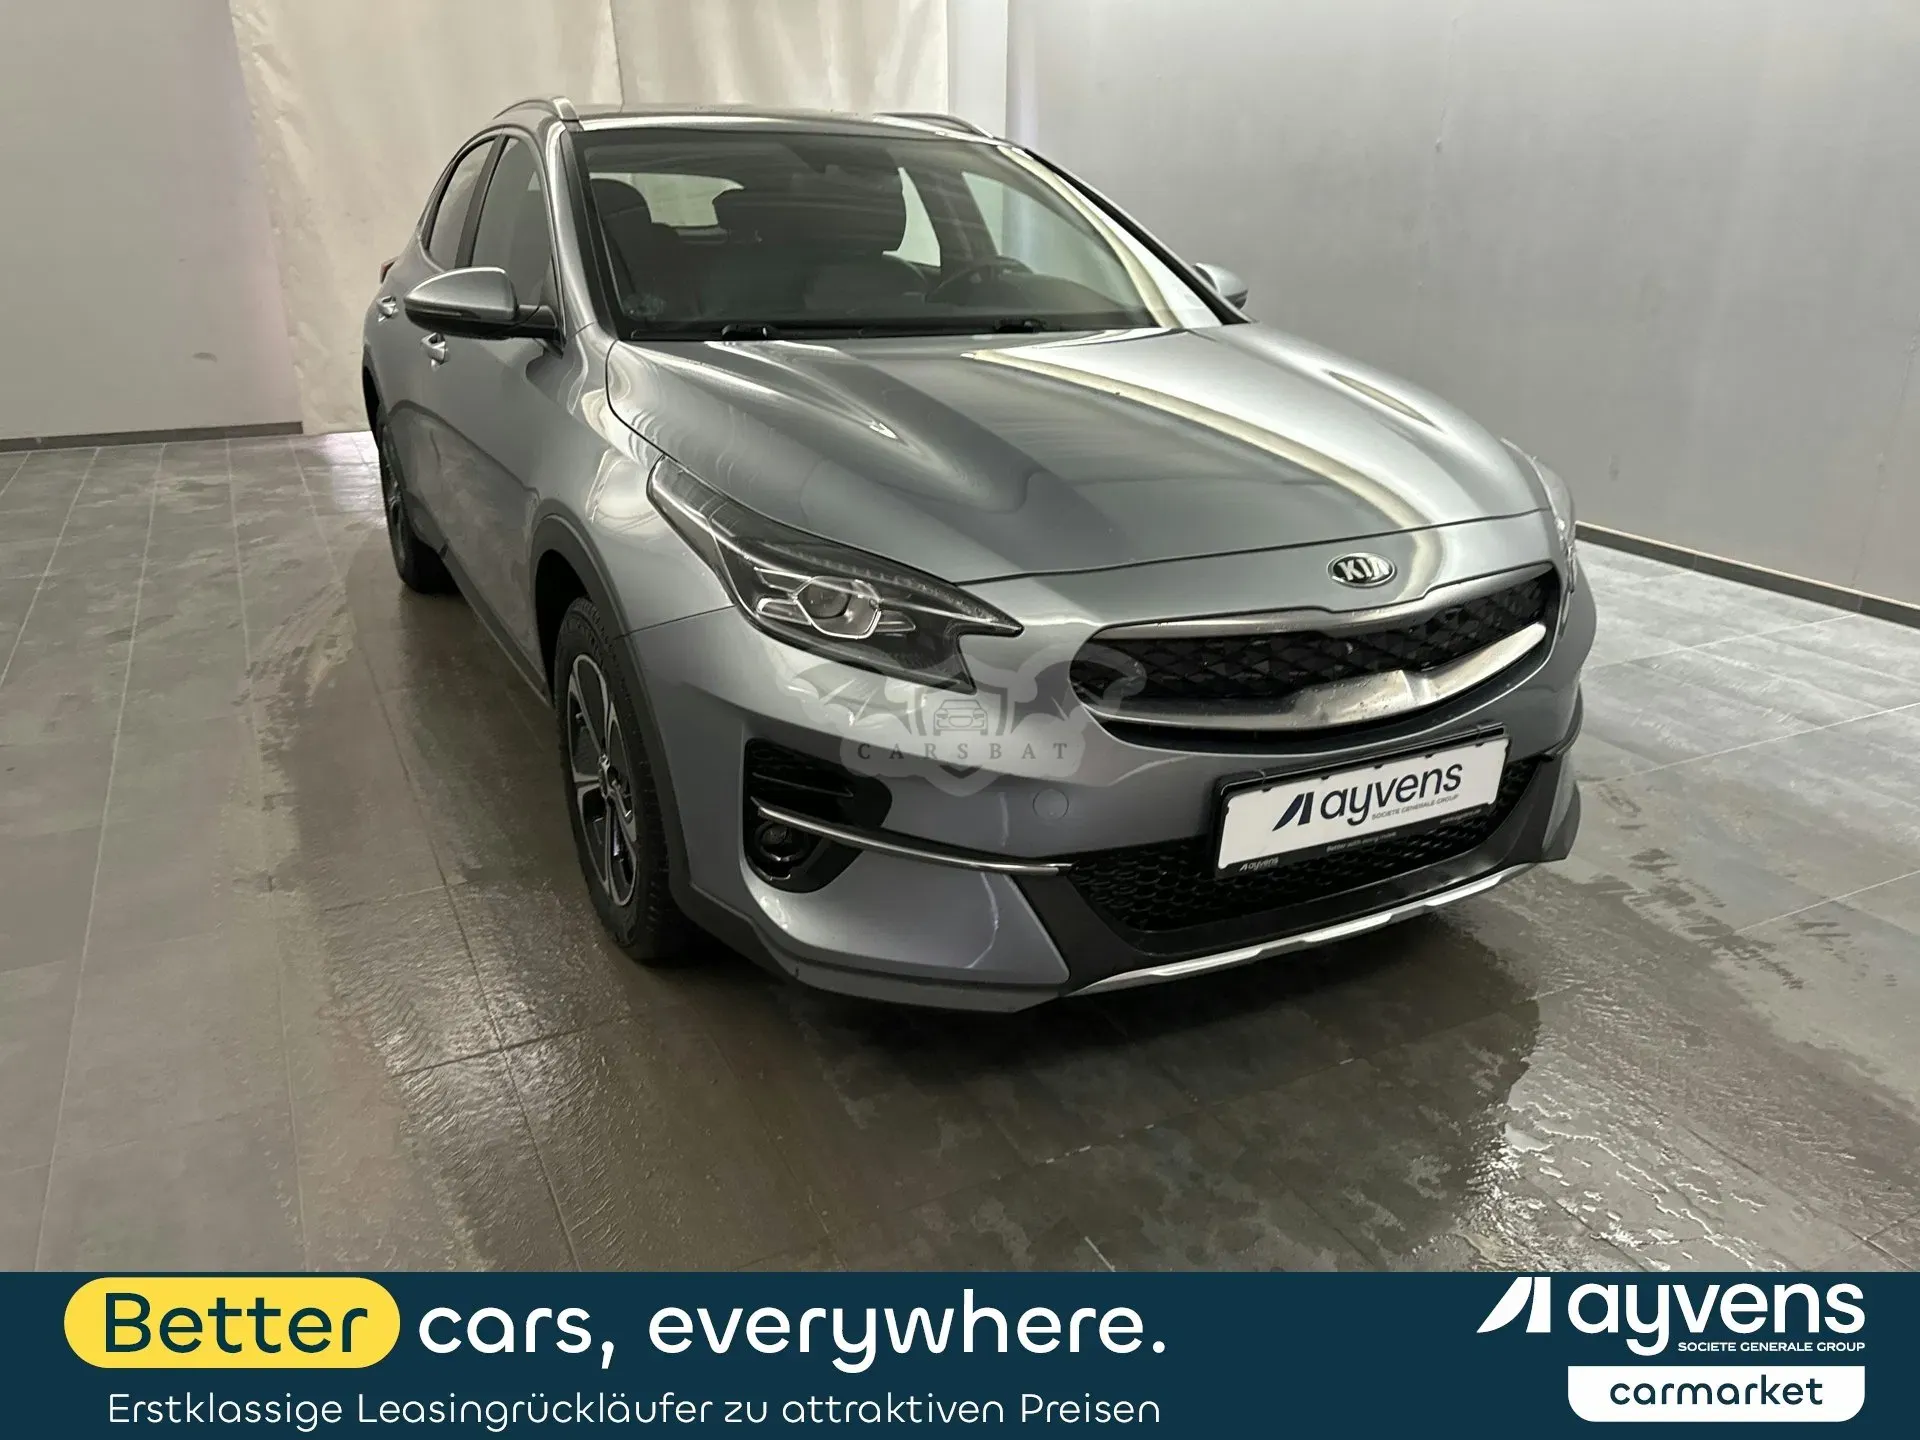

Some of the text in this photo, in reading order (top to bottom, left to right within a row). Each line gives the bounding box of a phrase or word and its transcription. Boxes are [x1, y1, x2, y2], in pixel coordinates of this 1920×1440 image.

[1338, 558, 1389, 580] KIA
[1320, 763, 1463, 826] ayvens
[1372, 807, 1400, 820] SOCIETE
[1401, 799, 1435, 814] GENERALE
